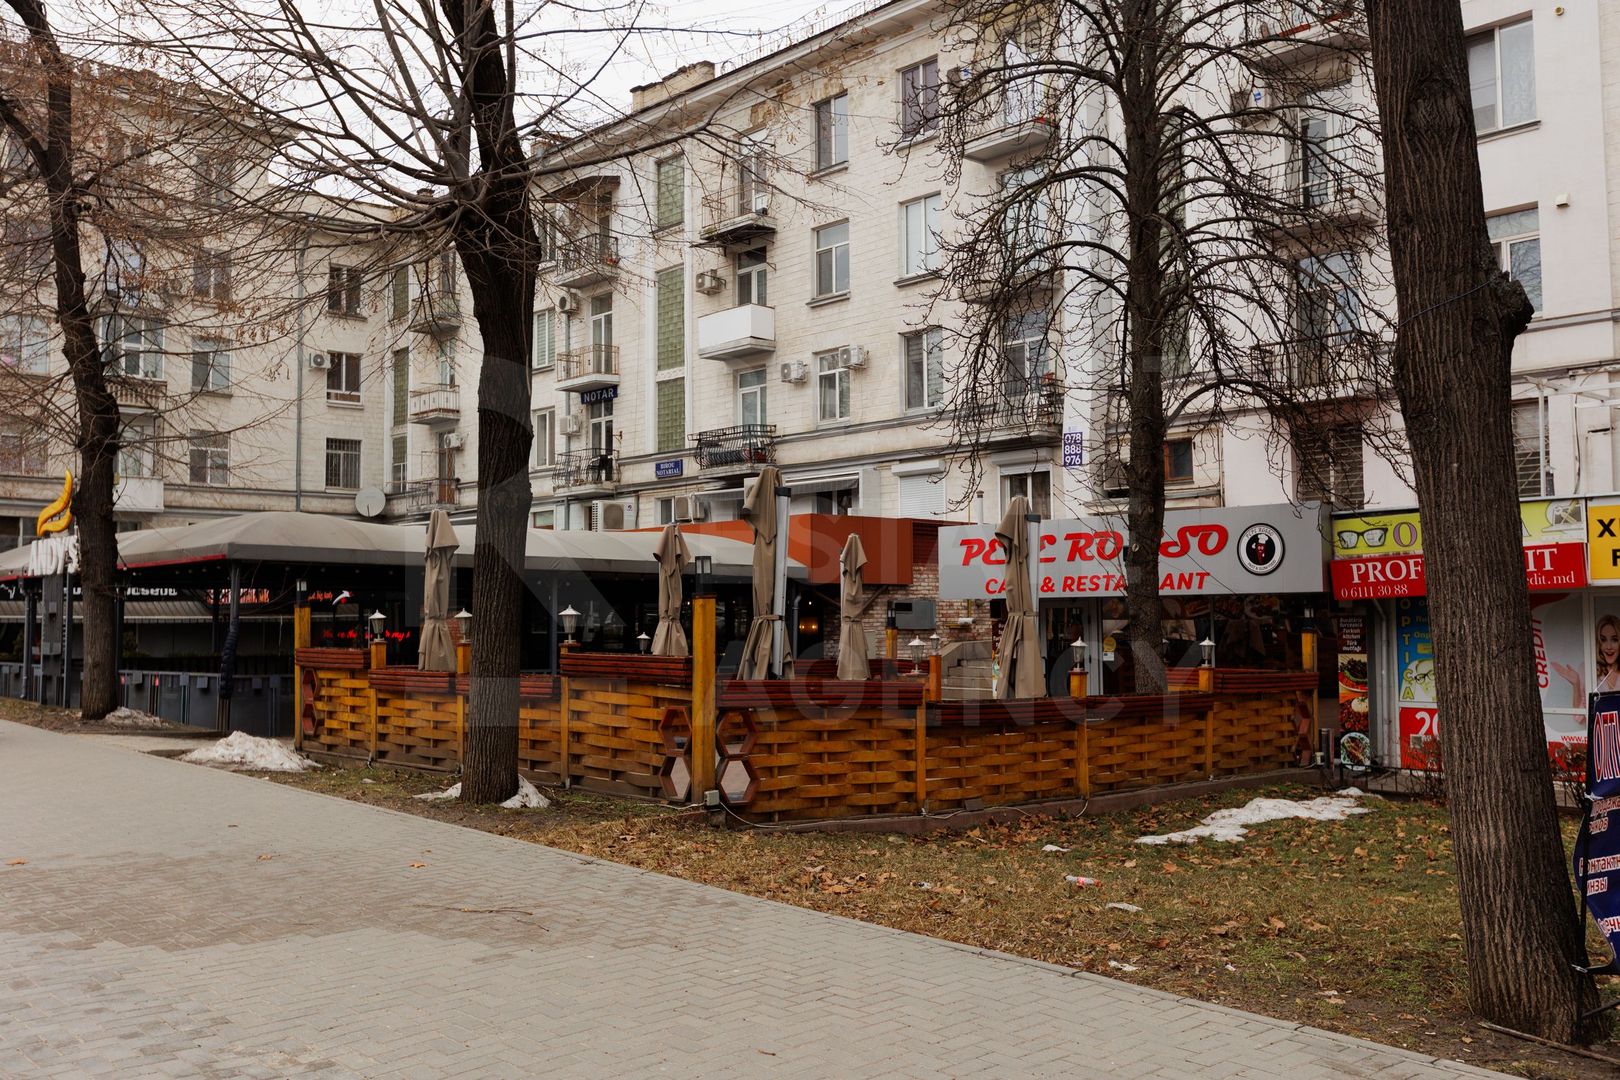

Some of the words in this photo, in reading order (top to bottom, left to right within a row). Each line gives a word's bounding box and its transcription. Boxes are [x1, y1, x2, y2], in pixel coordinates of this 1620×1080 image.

[584, 388, 614, 402] NOTAR
[1065, 433, 1081, 443] 078
[1064, 444, 1081, 454] 888
[1065, 455, 1081, 465] 976
[656, 468, 680, 476] NOTARIAL
[960, 534, 1056, 566] PEE
[1064, 524, 1228, 562] ROSO
[1350, 558, 1424, 583] PROF
[1040, 576, 1055, 592] &
[1062, 572, 1210, 592] RESTAANT
[1527, 571, 1575, 586] dit.md
